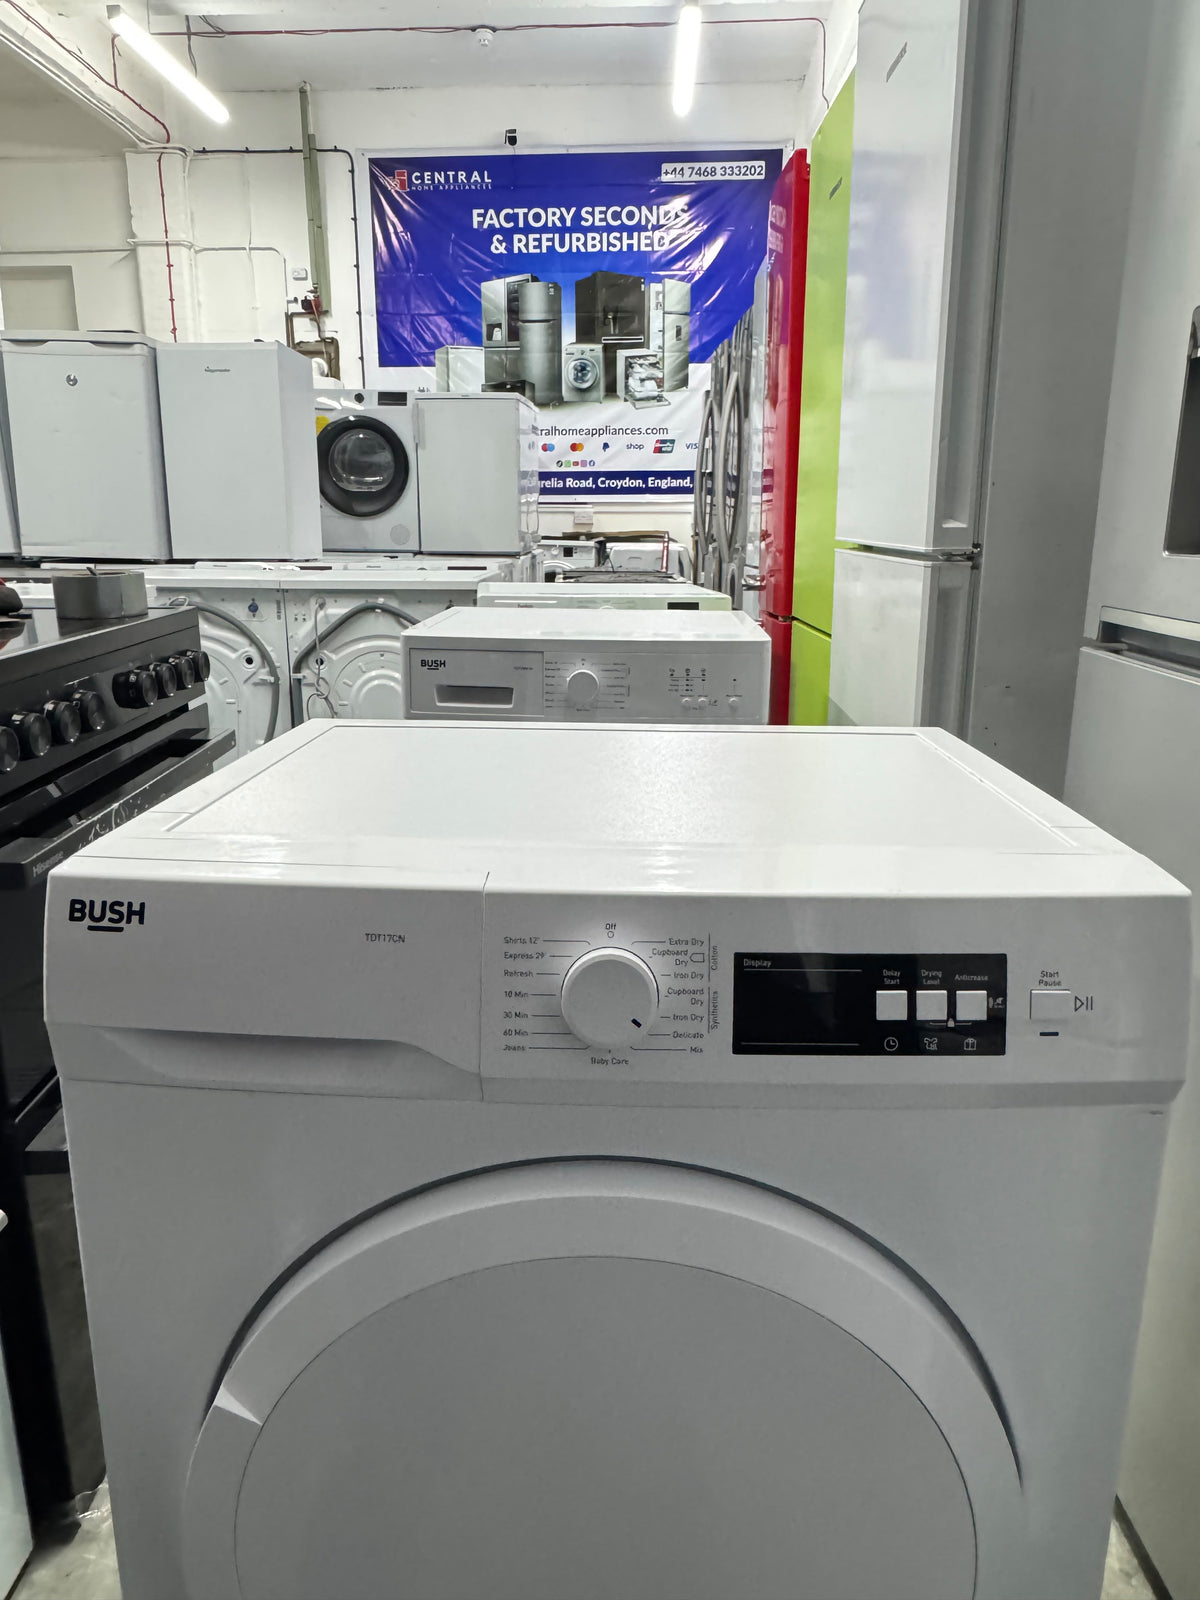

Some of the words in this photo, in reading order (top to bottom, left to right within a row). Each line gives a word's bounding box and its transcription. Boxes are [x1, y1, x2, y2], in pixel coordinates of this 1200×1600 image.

[687, 166, 717, 178] 7468
[720, 165, 764, 176] 333202
[411, 170, 492, 184] CENTRAL
[472, 207, 577, 229] FACTORY
[490, 234, 507, 254] &
[513, 231, 671, 253] REFURBISHED
[539, 425, 668, 437] ralhomeappliances.com
[626, 442, 645, 451] shop
[566, 476, 596, 489] Road,
[597, 476, 646, 490] Croydon,
[648, 475, 694, 489] England,
[420, 659, 446, 668] BUSH
[68, 898, 146, 925] BUSH
[605, 922, 617, 931] Off
[668, 937, 689, 946] Extra
[691, 938, 705, 947] Dry
[504, 951, 534, 961] Express
[652, 948, 689, 957] Cupboard
[674, 958, 689, 968] Dry
[710, 945, 719, 971] Cotton
[743, 958, 772, 968] Display
[673, 971, 689, 979] Iron
[690, 971, 705, 981] Dry
[921, 969, 942, 979] Drying
[1040, 970, 1060, 978] Start
[1038, 979, 1062, 987] Pause
[504, 990, 513, 998] 10
[514, 990, 529, 998] Min
[667, 987, 705, 997] Cupboard
[690, 997, 704, 1007] Dry
[514, 1011, 529, 1019] Min
[690, 1013, 705, 1023] Dry
[611, 1057, 629, 1065] Care
